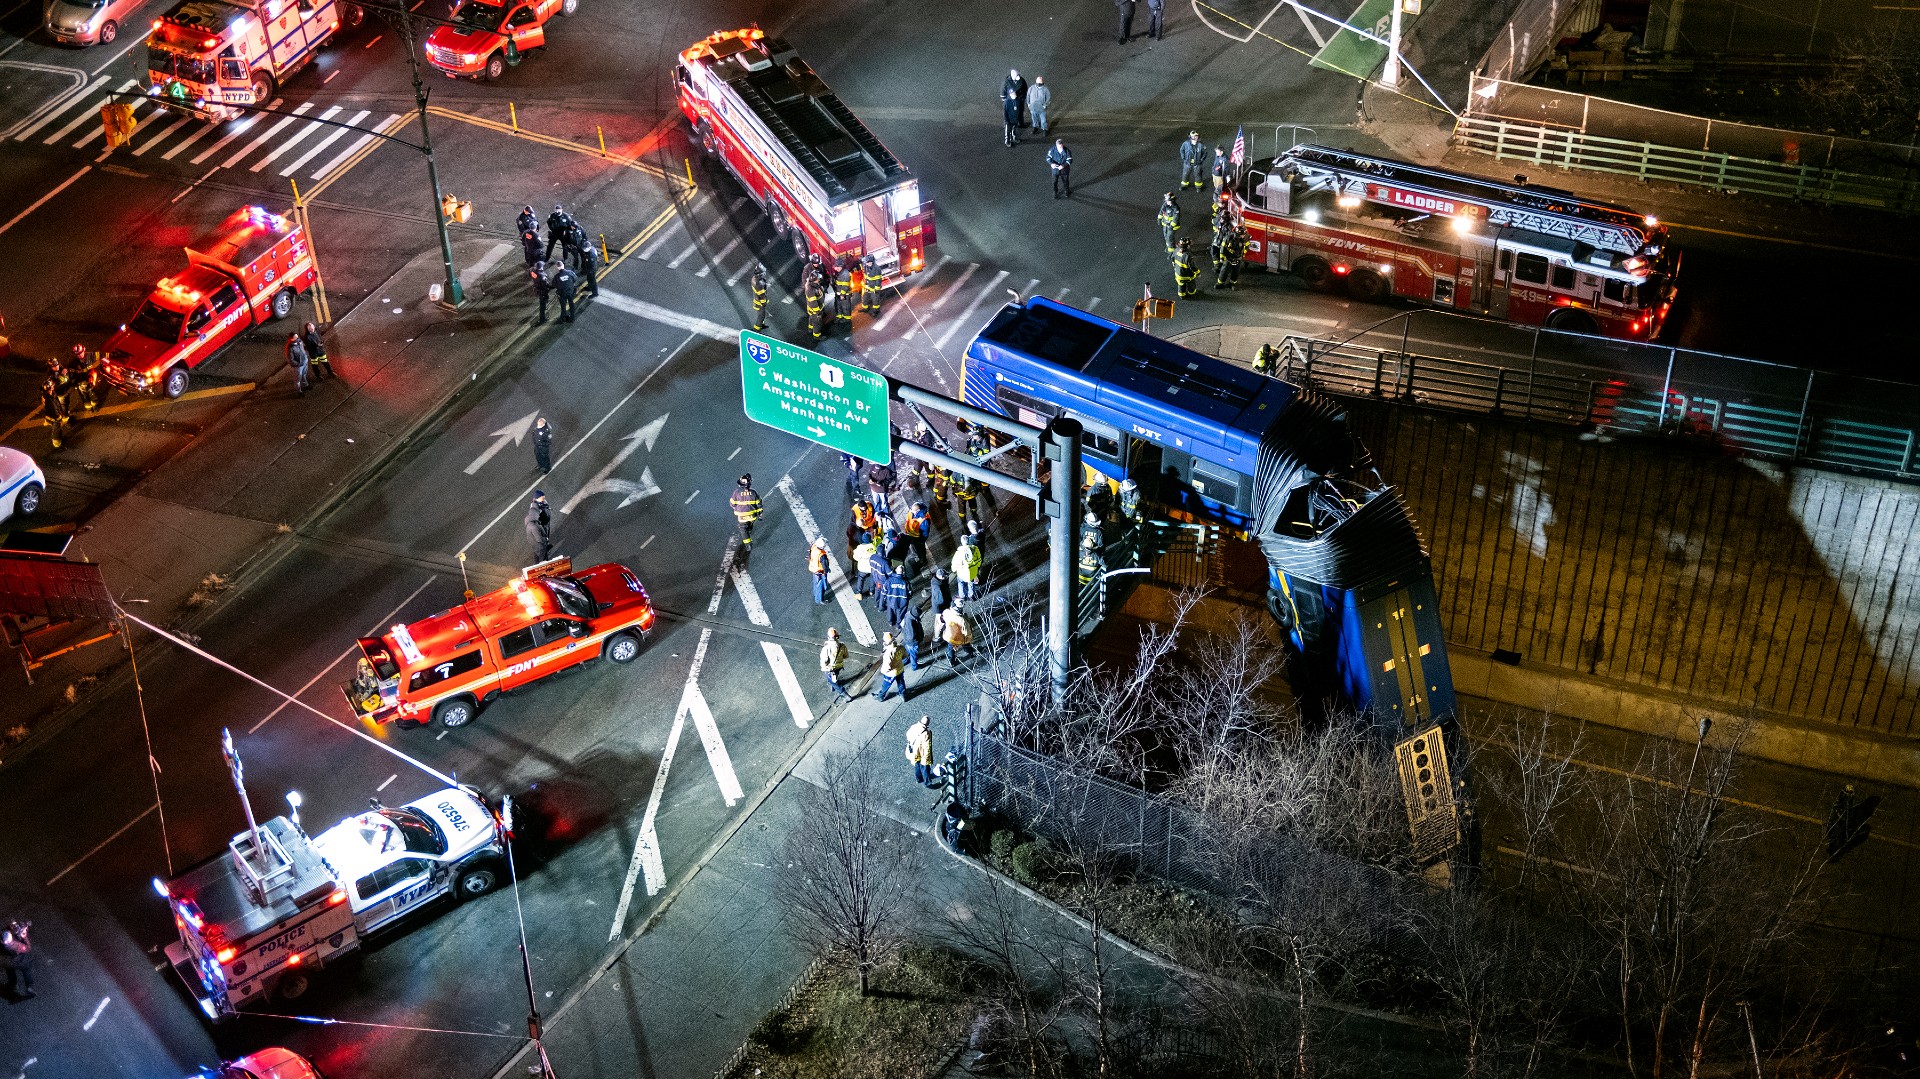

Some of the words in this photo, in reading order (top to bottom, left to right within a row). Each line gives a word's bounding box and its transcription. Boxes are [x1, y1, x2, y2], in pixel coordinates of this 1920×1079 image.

[225, 93, 250, 101] NYPD
[1395, 192, 1454, 213] LADDER
[906, 229, 913, 237] 3
[1327, 237, 1364, 252] FDNY
[1518, 289, 1538, 303] 49
[223, 305, 245, 328] FDNY
[749, 345, 768, 360] 95
[776, 346, 808, 363] SOUTH
[829, 370, 834, 382] 1
[850, 371, 884, 389] SOUTH
[758, 367, 767, 377] G
[773, 371, 851, 406] Washington
[855, 399, 872, 418] Br
[762, 381, 837, 415] Amsterdam
[845, 410, 869, 425] Ave
[780, 400, 851, 432] Manhattan
[440, 667, 449, 679] 7
[508, 657, 543, 678] FDNY
[397, 880, 436, 908] NYPD
[258, 925, 306, 957] POLICE
